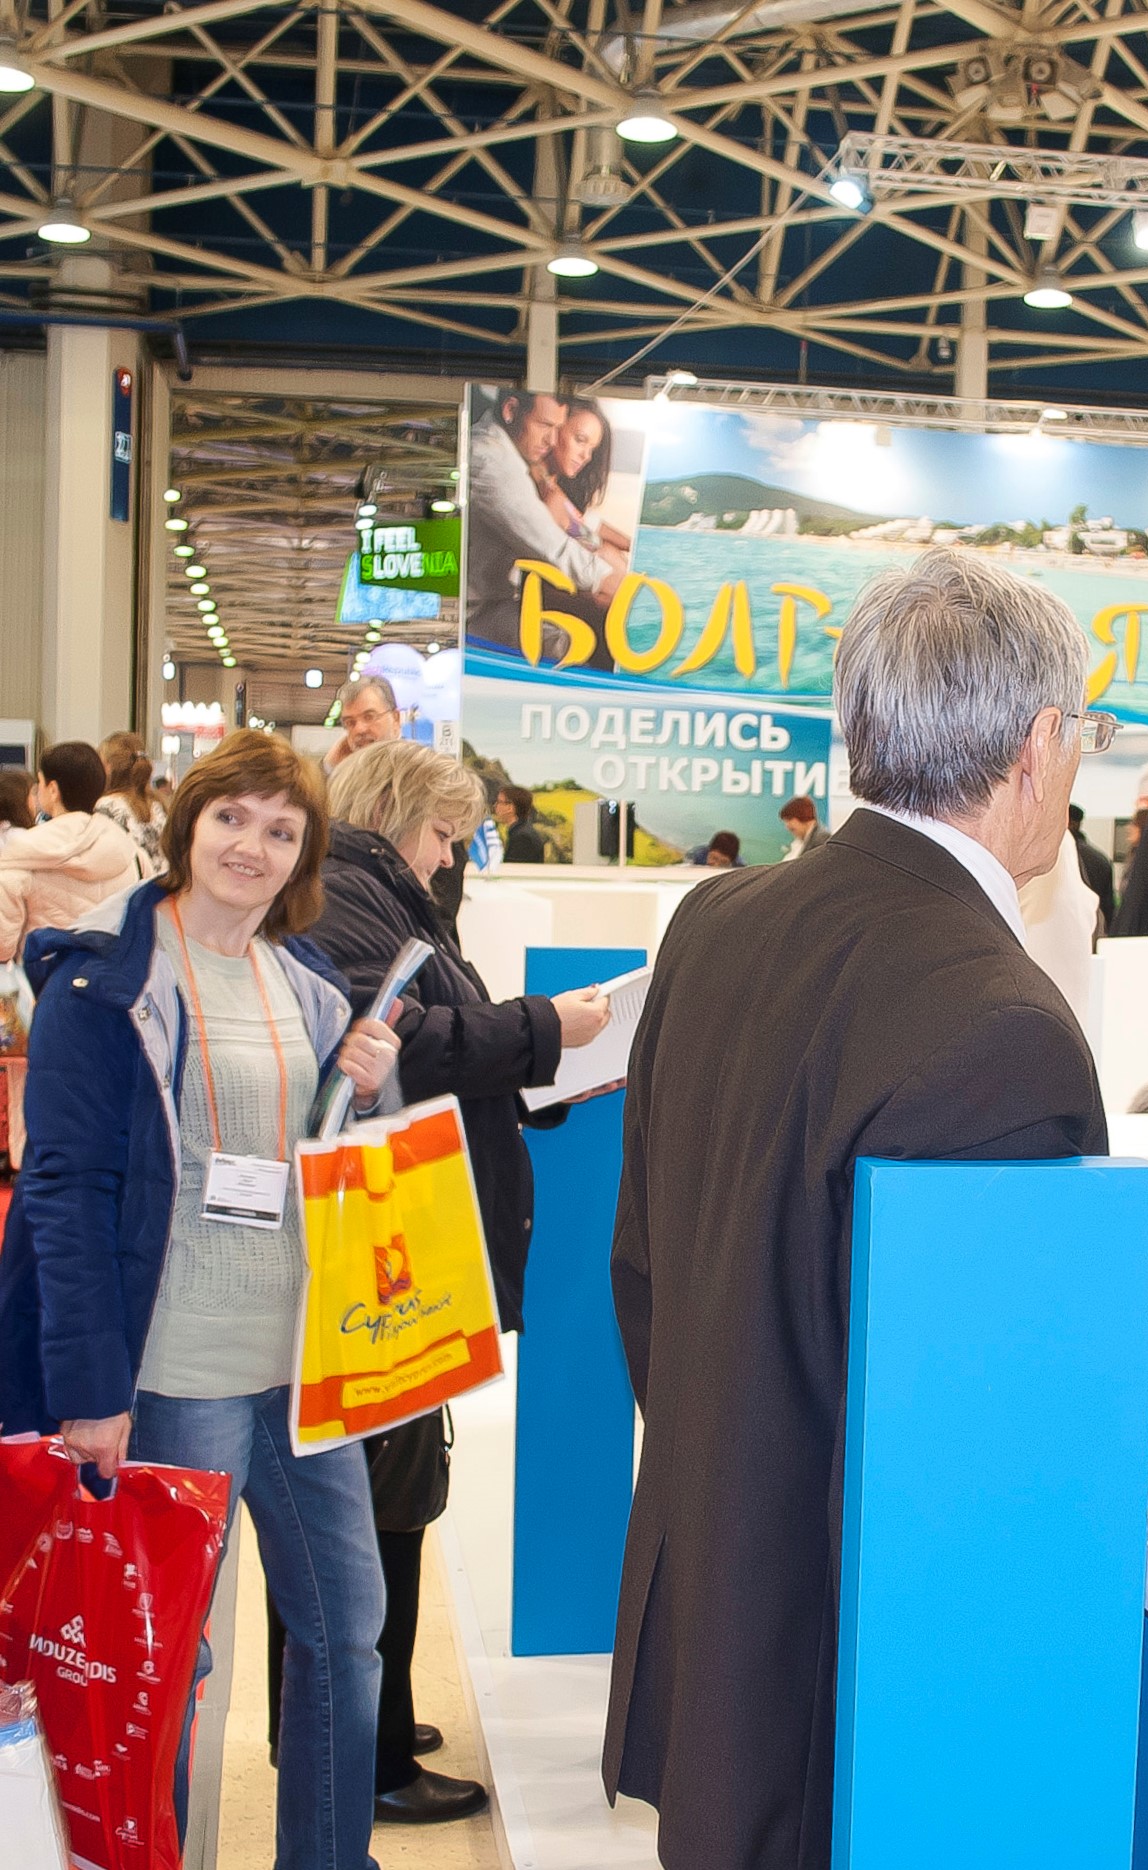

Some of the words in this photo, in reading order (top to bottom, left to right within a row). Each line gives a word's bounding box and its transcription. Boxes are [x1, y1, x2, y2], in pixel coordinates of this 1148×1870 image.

[361, 529, 373, 554] I
[373, 526, 421, 553] FEEL
[520, 703, 791, 751] ПОДЕЛИСЬ
[29, 1633, 117, 1684] MOUZEIDIS
[56, 1666, 88, 1687] GROU
